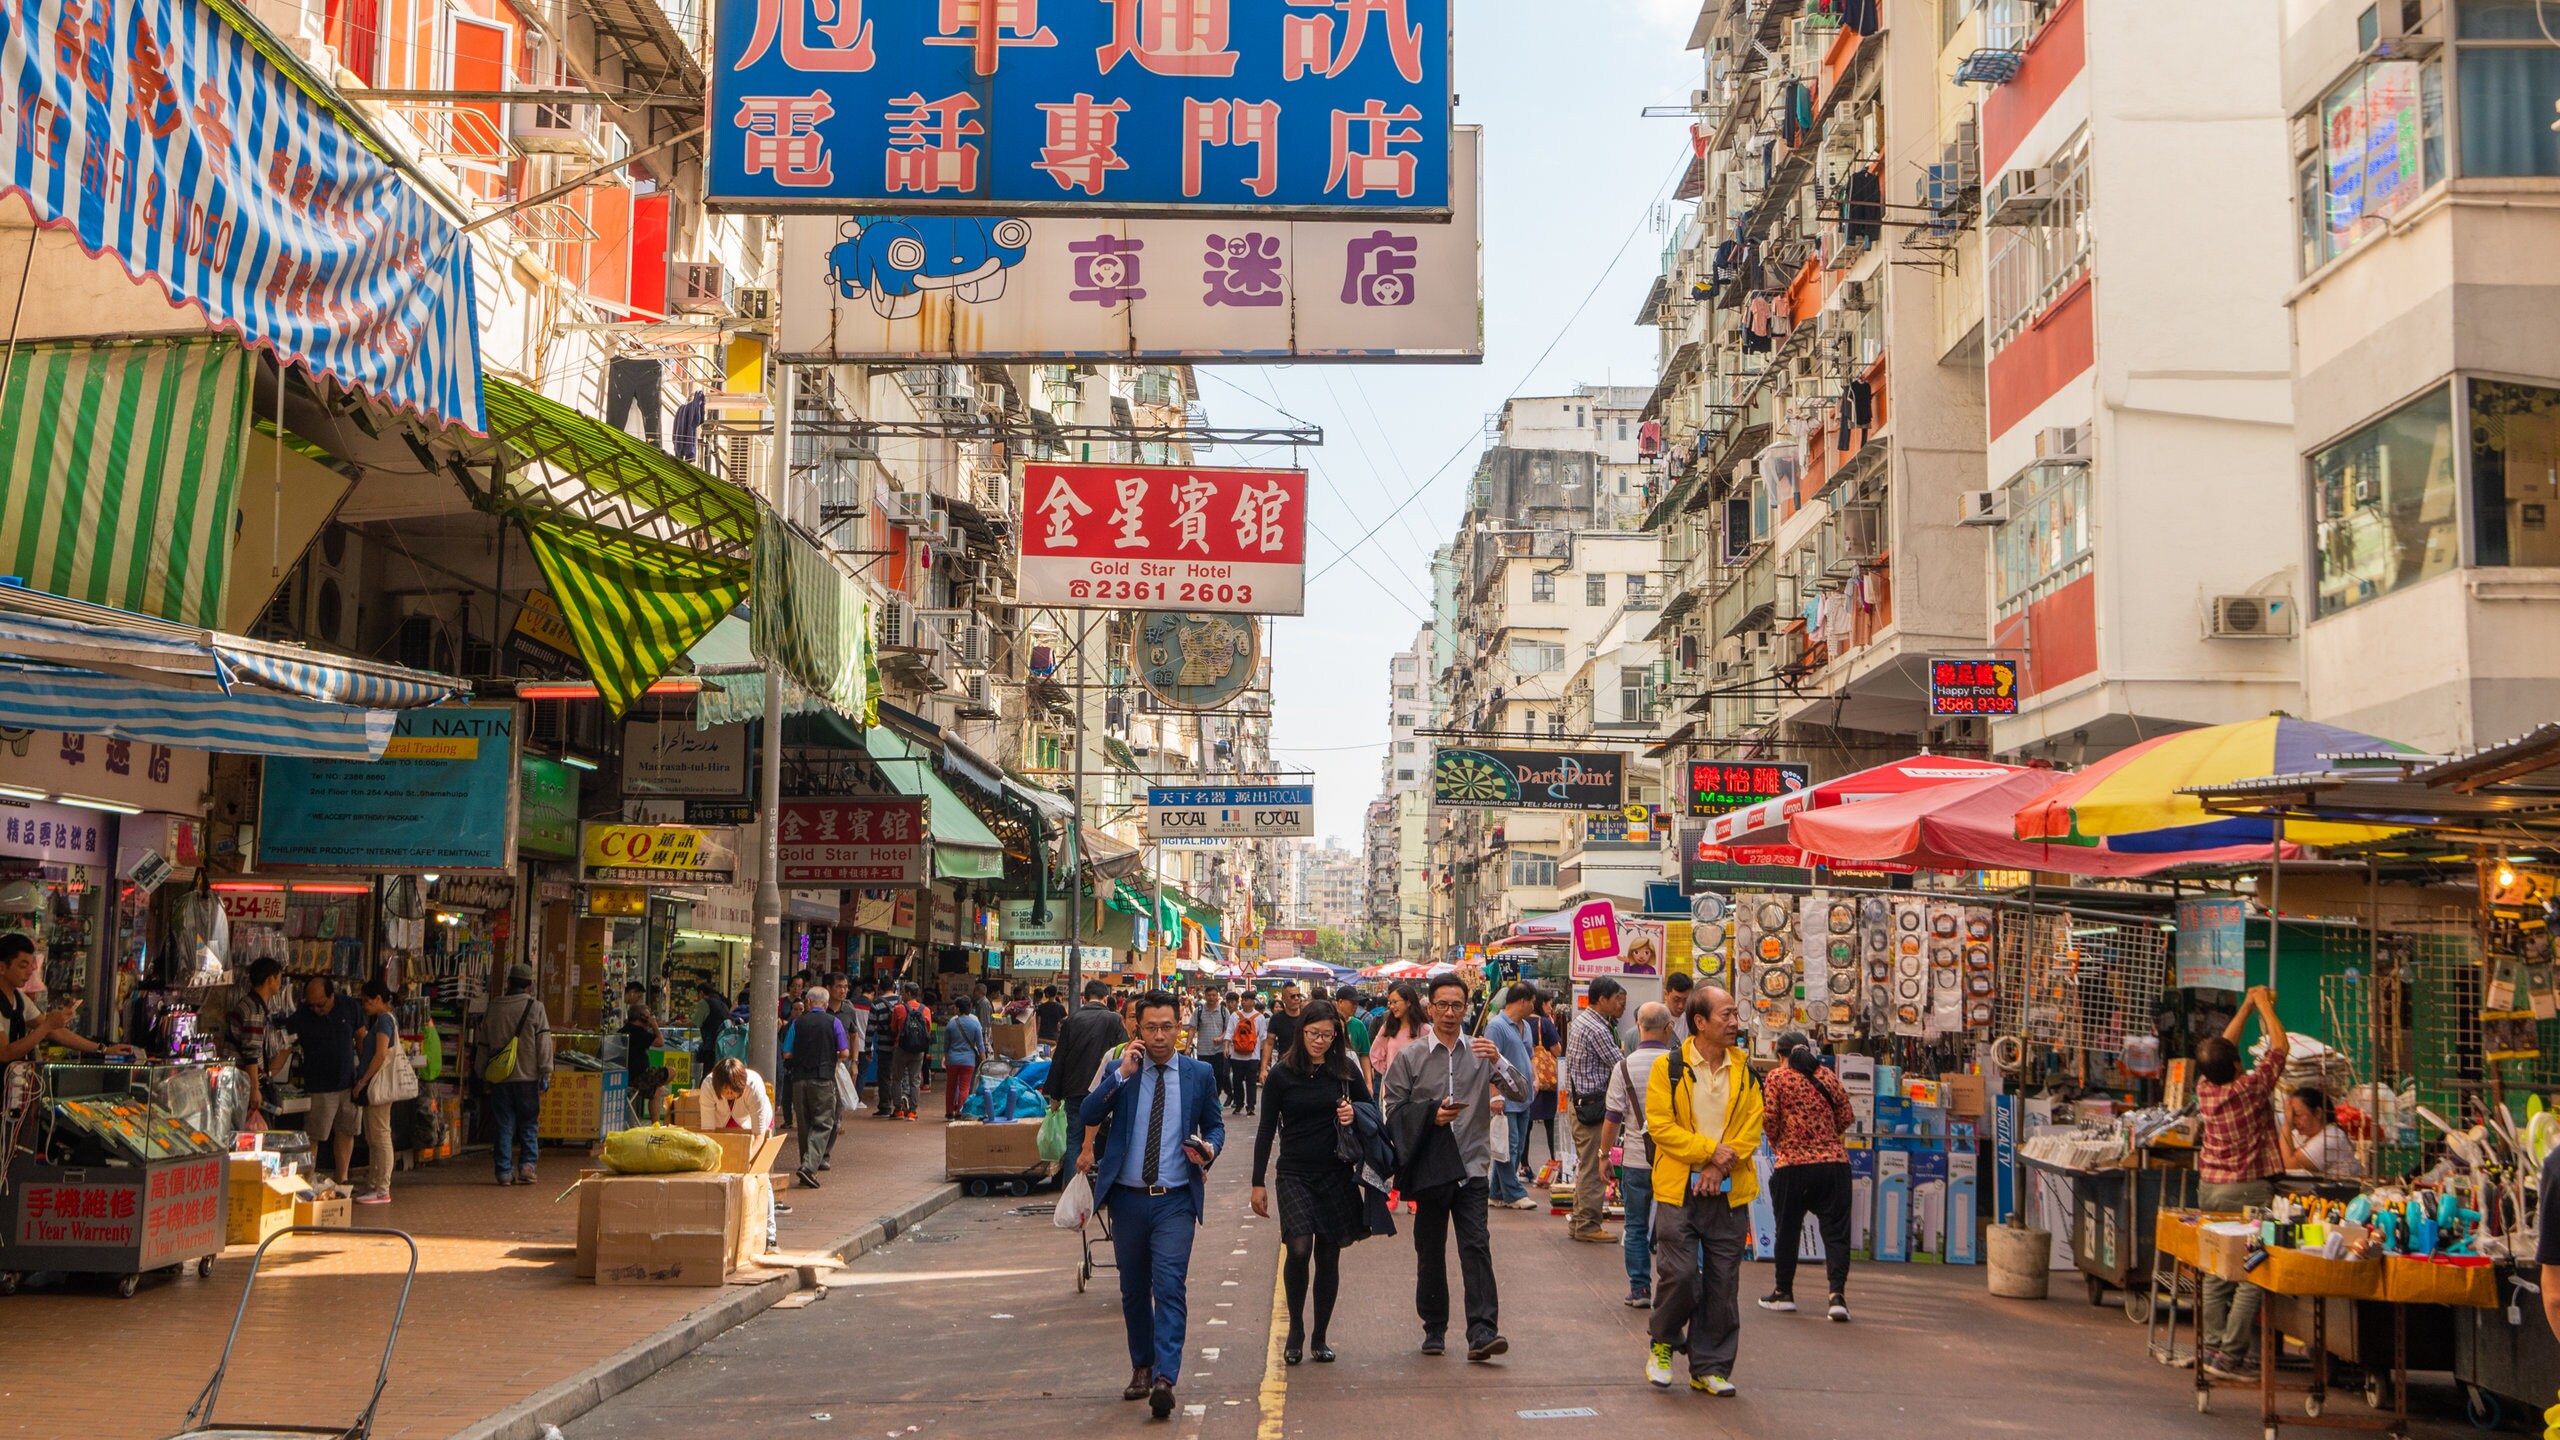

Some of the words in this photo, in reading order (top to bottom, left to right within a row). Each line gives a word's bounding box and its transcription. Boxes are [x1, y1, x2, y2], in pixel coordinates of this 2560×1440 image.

[734, 88, 1423, 199] 電話專門店
[143, 172, 158, 231] &
[172, 188, 231, 274] VIDEO
[1067, 229, 1415, 308] 車迷店
[1090, 561, 1129, 576] Gold
[1140, 563, 1176, 577] Star
[1187, 564, 1232, 579] Hotel
[1097, 580, 1167, 601] 2361
[1180, 582, 1253, 604] 2603
[1937, 686, 1970, 697] Happy
[1972, 686, 1996, 696] Foot
[1937, 697, 1974, 711] 3586
[1977, 697, 2015, 711] 9396
[414, 742, 458, 756] Trading
[1516, 764, 1614, 787] DartsPoint
[310, 788, 326, 796] 2nd
[328, 788, 349, 796] Floor
[1158, 790, 1227, 804] 天下名器
[1437, 797, 1520, 807] www.dartspoint.com
[1522, 800, 1541, 808] TEL:
[1161, 811, 1208, 827] FOCAL
[1254, 811, 1301, 826] FOCAL
[366, 848, 407, 856] INTERNET
[438, 849, 492, 857] REMITTANCE
[778, 848, 815, 861] Gold
[825, 848, 859, 861] Star
[870, 848, 912, 861] Hotel
[75, 865, 85, 879] PS
[1581, 914, 1606, 929] SIM
[1997, 1106, 2010, 1150] DIGITAL
[1998, 1152, 2011, 1169] TV
[150, 1160, 220, 1201] 高價收機
[26, 1187, 137, 1219] 手機維修
[147, 1195, 218, 1237] 手機維修
[25, 1220, 31, 1240] 1
[37, 1221, 67, 1241] Year
[71, 1222, 133, 1246] Warrenty
[154, 1237, 175, 1258] Year
[176, 1228, 215, 1252] Warrenty
